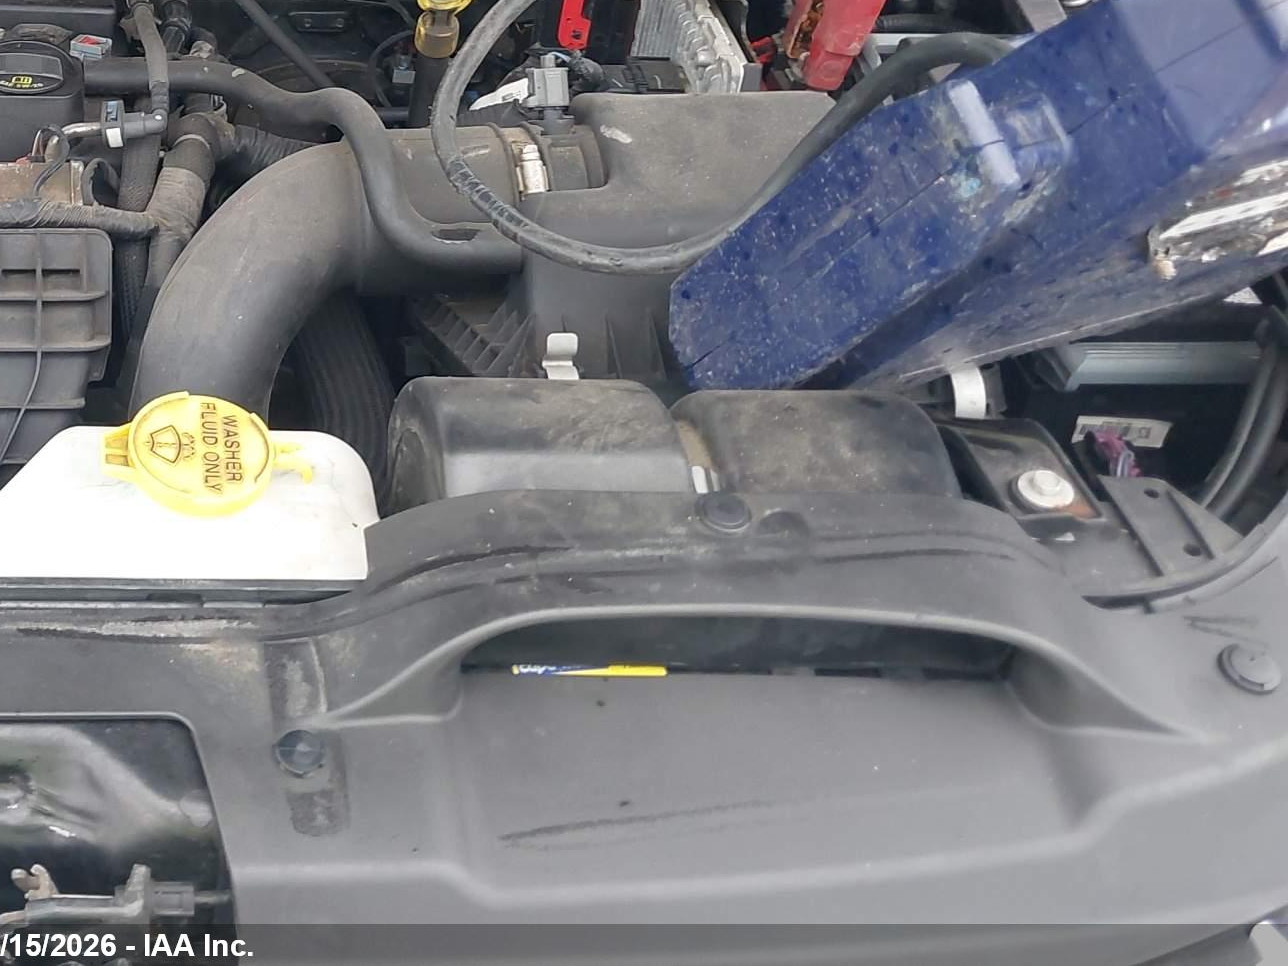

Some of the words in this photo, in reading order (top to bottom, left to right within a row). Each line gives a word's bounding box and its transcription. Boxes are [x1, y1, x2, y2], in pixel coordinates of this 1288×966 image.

[200, 402, 218, 446] FLUID
[222, 414, 243, 483] WASHER
[203, 451, 224, 493] ONLY
